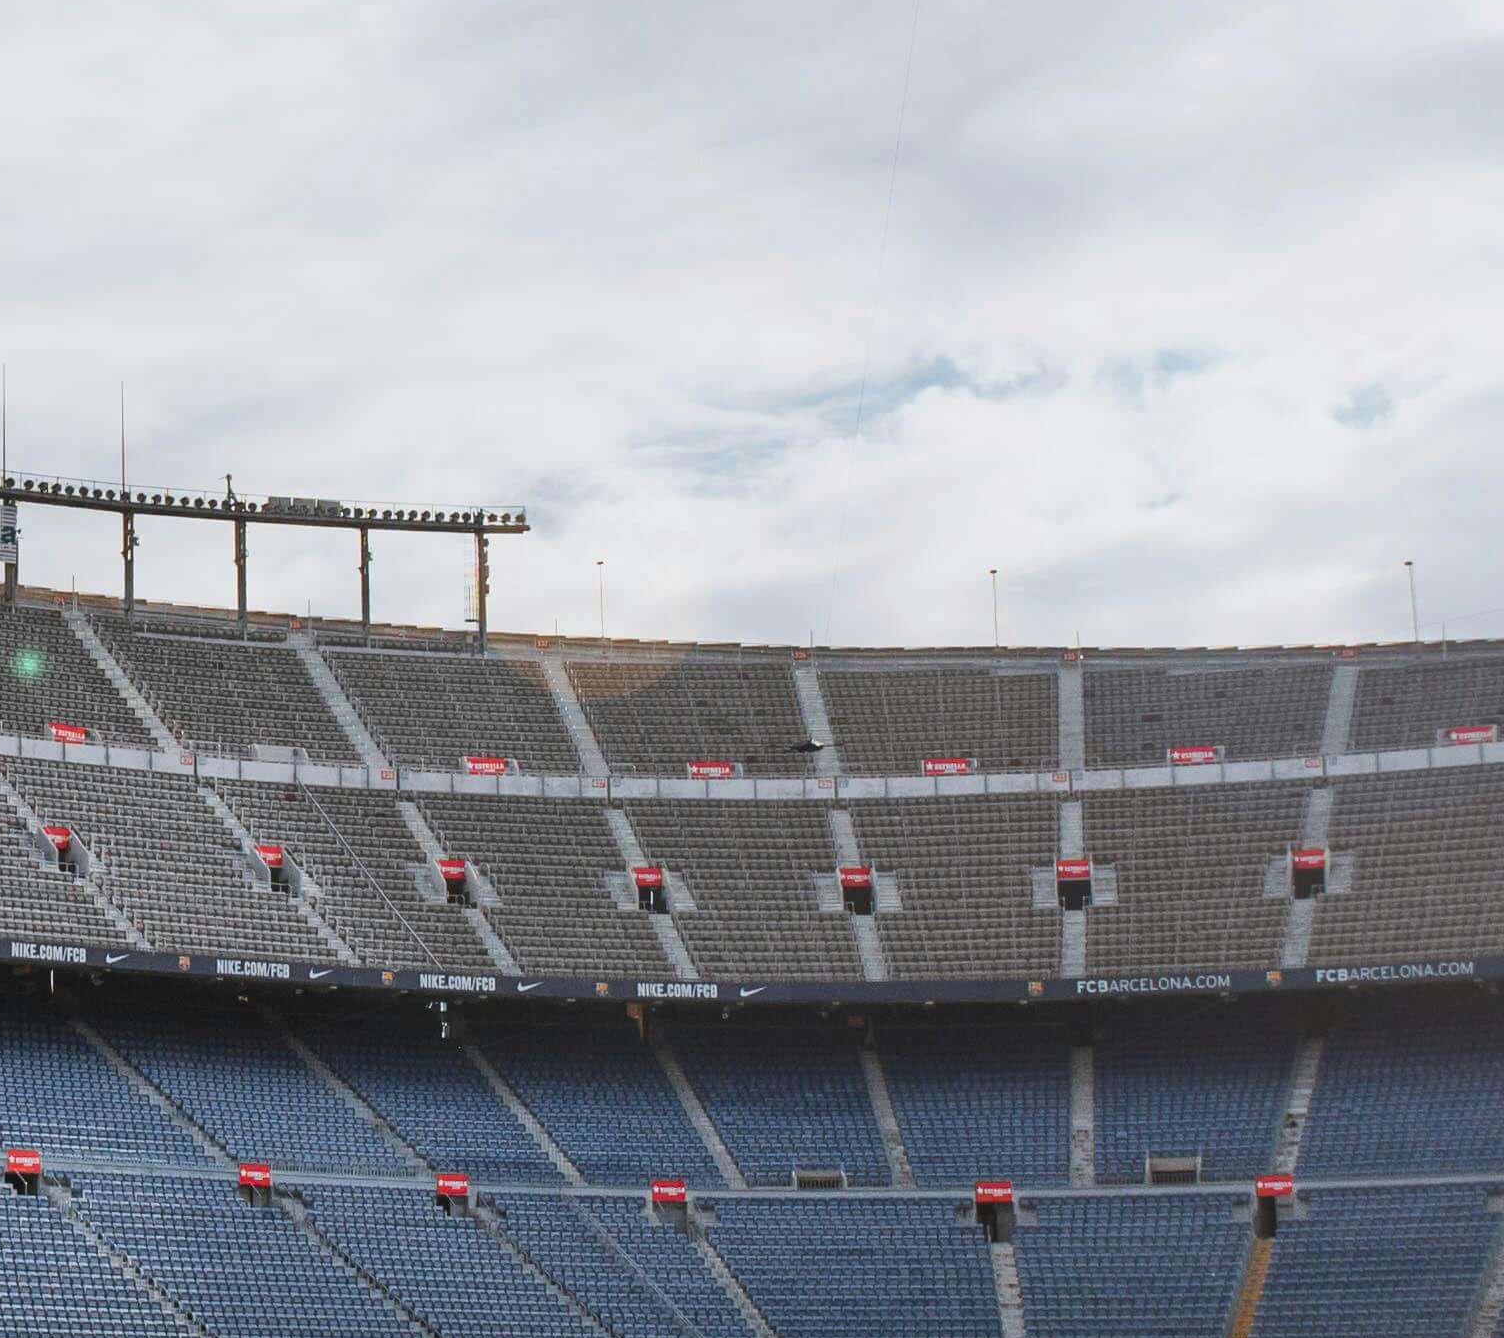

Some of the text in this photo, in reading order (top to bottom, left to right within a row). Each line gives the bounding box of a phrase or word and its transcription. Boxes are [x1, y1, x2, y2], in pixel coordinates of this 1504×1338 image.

[11, 942, 86, 963] NIKE.COM/FCB
[216, 959, 290, 979] NIKE.COM/FCB
[1315, 962, 1474, 982] FCBARCELONA.COM
[419, 973, 496, 992] NIKE.COM/FCB
[637, 982, 718, 999] NIKE.COM/FCB
[1077, 975, 1230, 993] FCBARCELONA.COM
